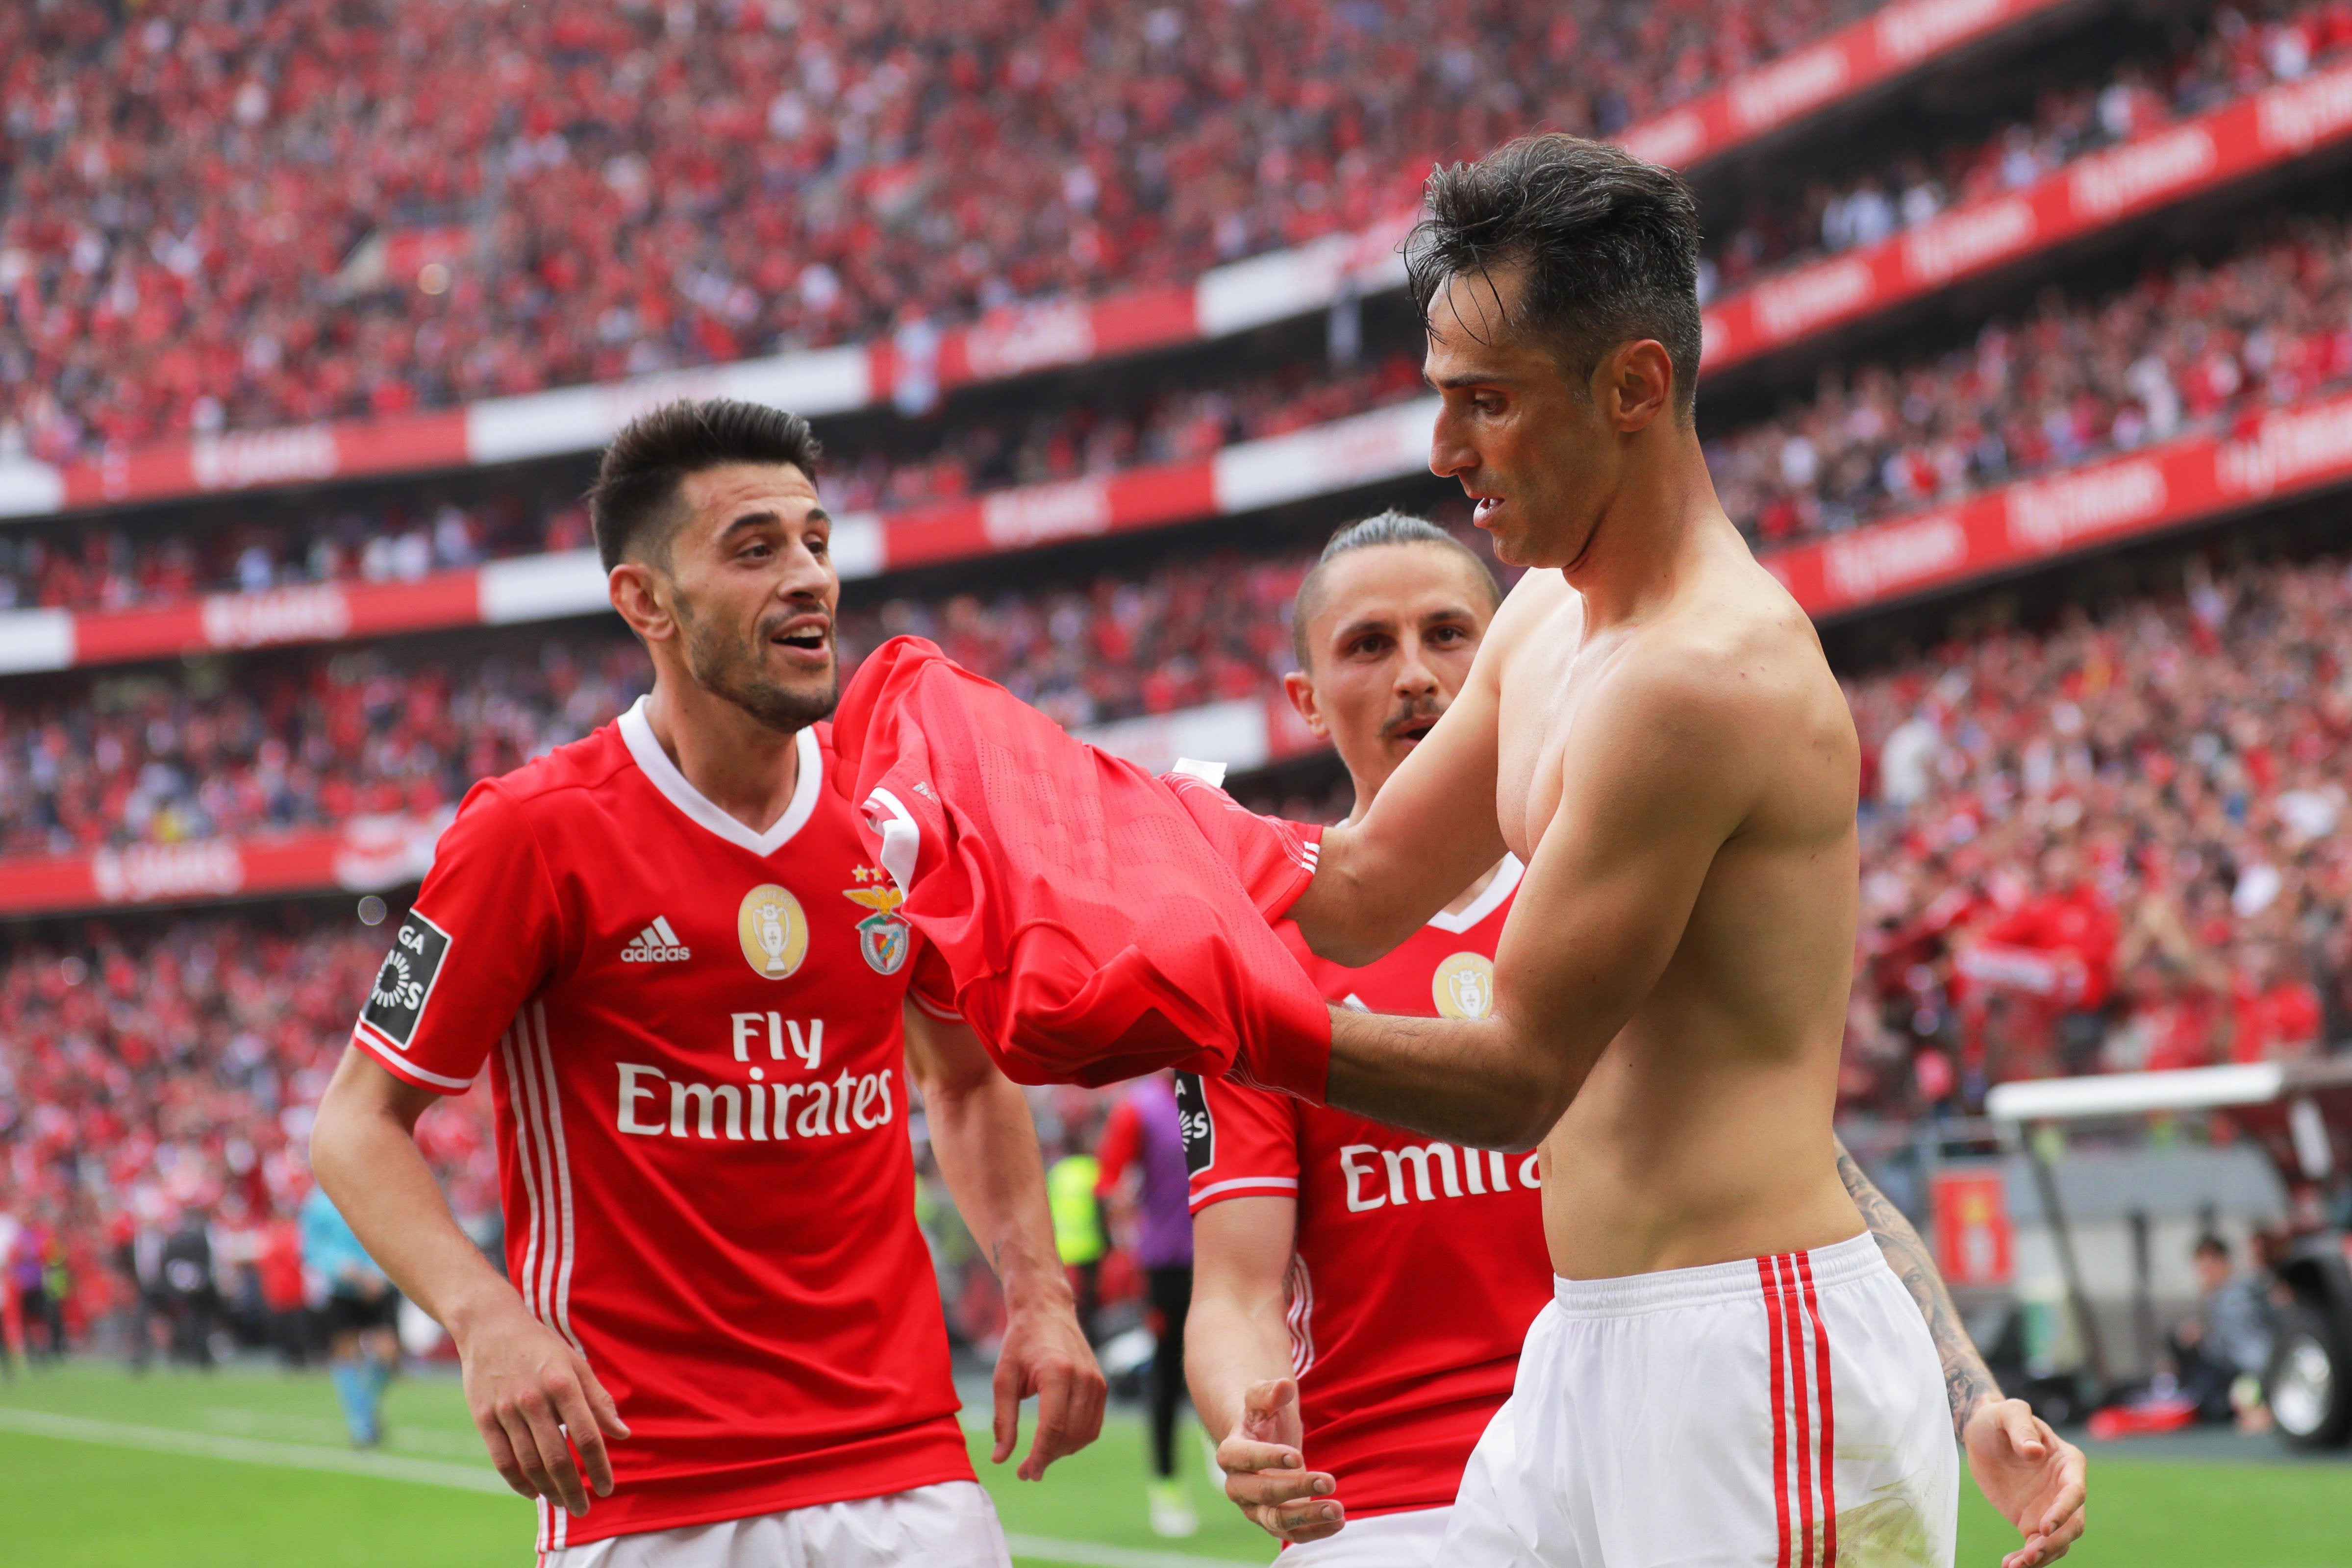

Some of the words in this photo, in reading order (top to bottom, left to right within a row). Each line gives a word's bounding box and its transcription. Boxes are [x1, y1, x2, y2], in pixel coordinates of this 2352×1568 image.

[398, 925, 425, 955] GA
[620, 945, 691, 962] adidas
[730, 1011, 824, 1069] Fly
[615, 1062, 893, 1141] Emirates
